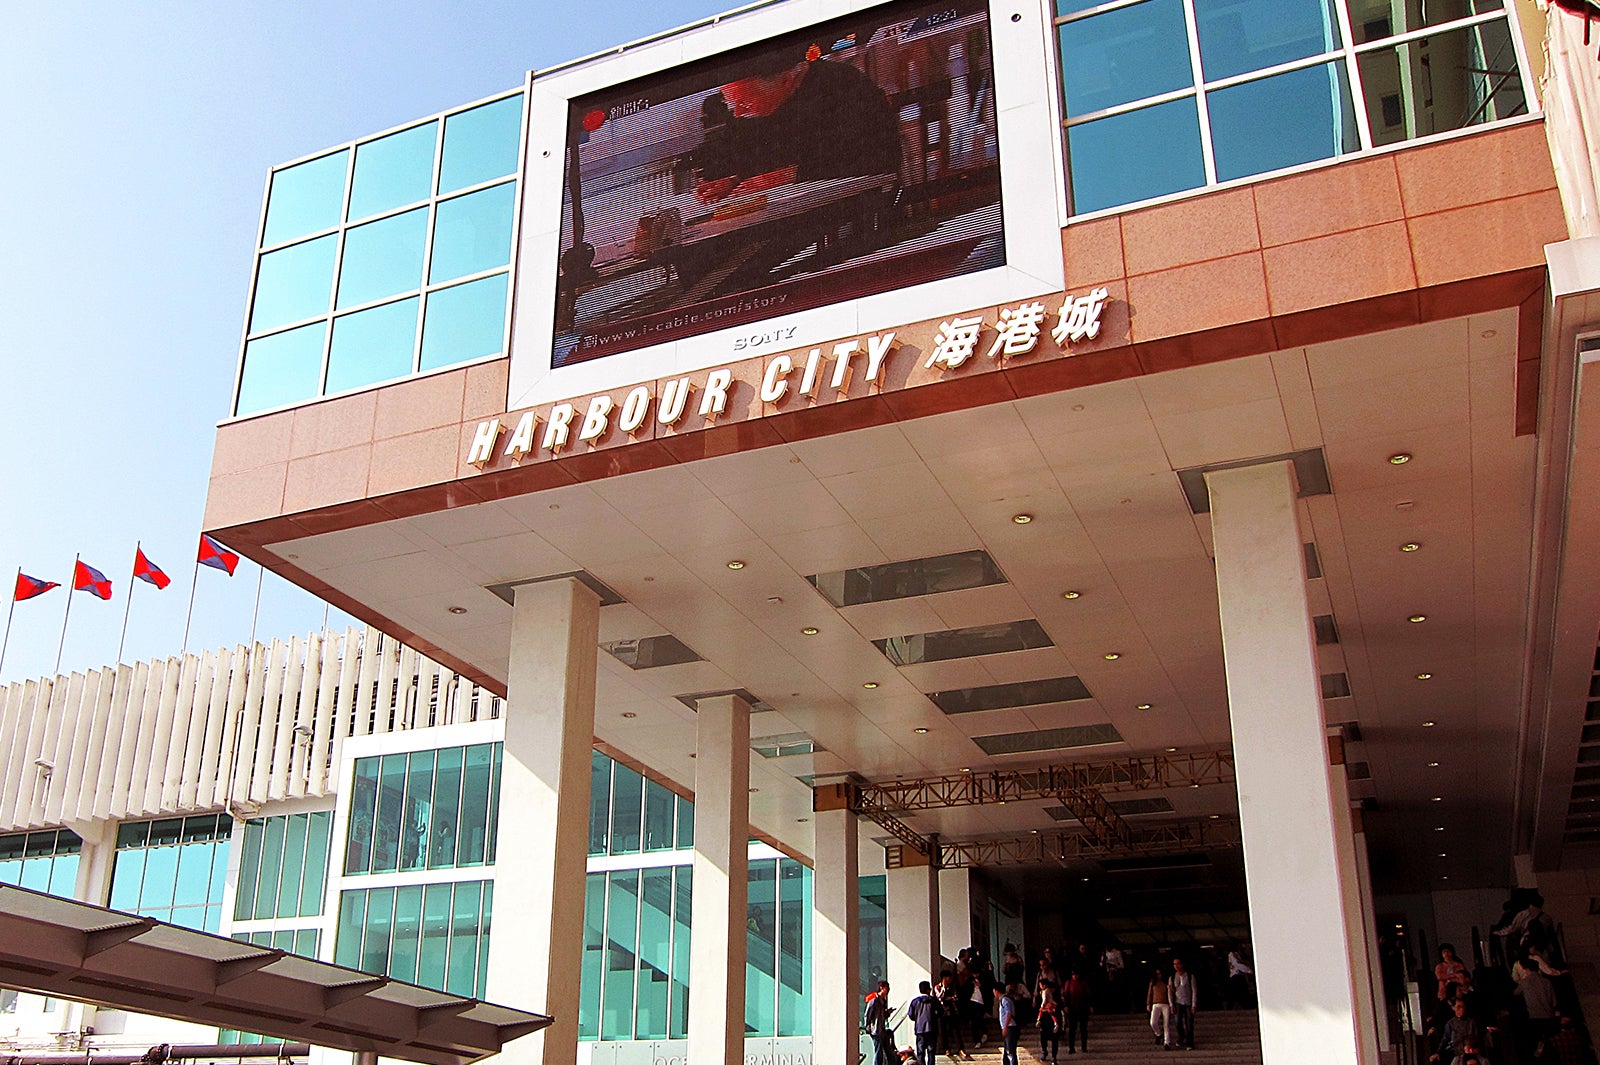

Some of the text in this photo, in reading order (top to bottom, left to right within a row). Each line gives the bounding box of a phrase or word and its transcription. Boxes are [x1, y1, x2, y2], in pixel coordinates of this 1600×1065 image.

[467, 287, 1110, 465] HARBOUR CITY 海港城
[733, 325, 798, 351] SONY
